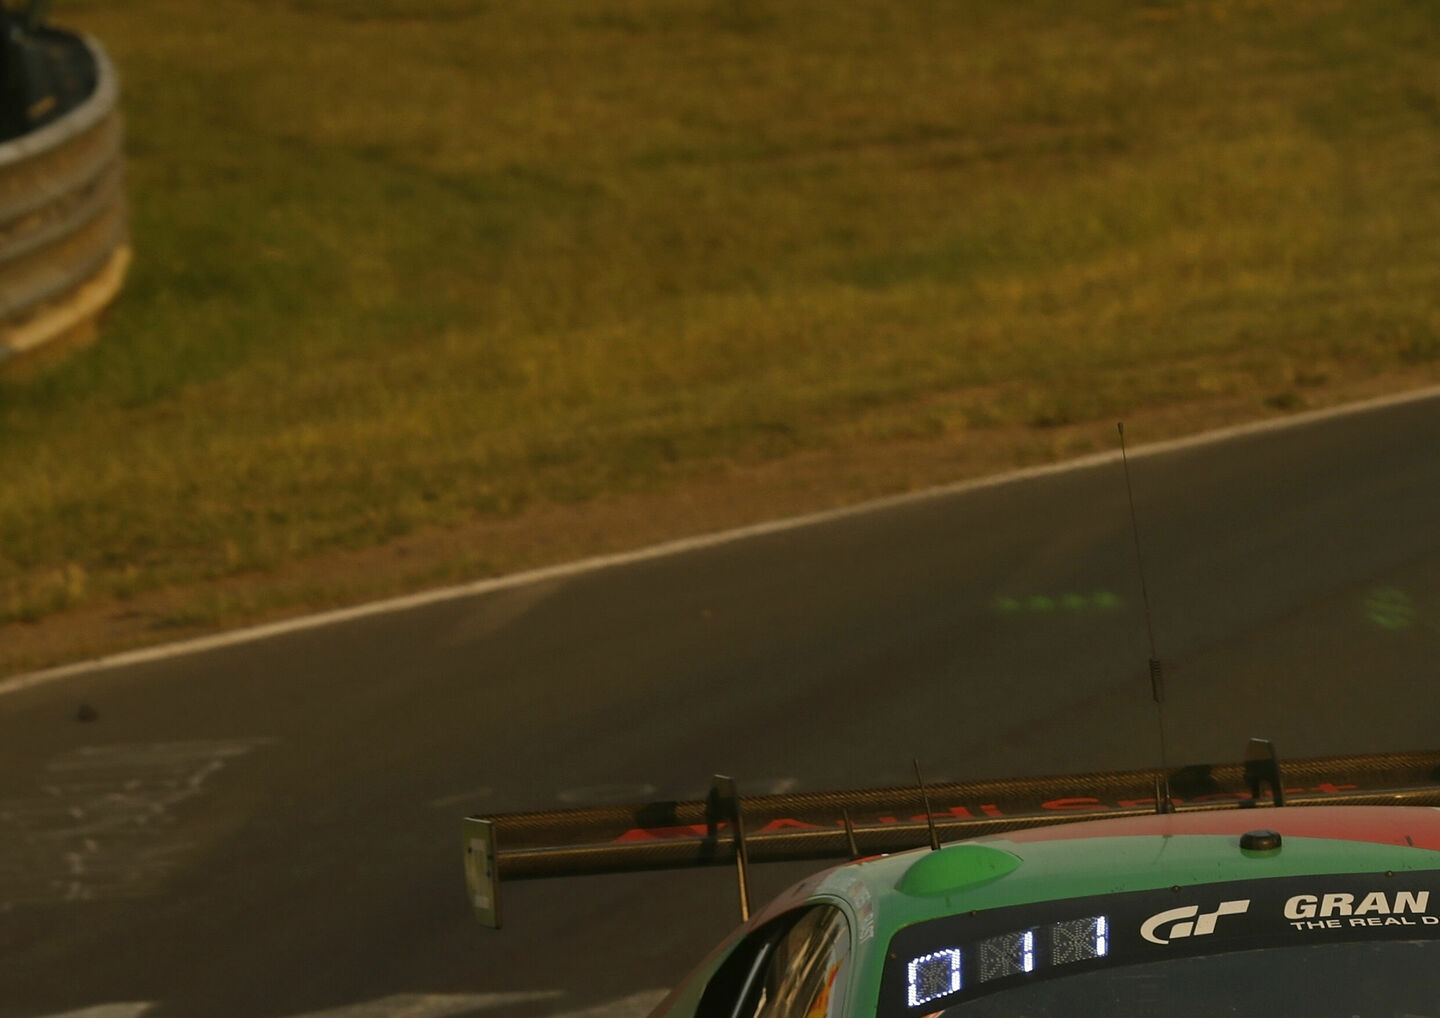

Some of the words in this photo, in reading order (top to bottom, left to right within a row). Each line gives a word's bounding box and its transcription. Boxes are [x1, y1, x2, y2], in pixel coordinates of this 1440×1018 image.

[1284, 891, 1432, 919] GRAN
[1290, 919, 1342, 931] THE
[1350, 916, 1416, 927] REAL
